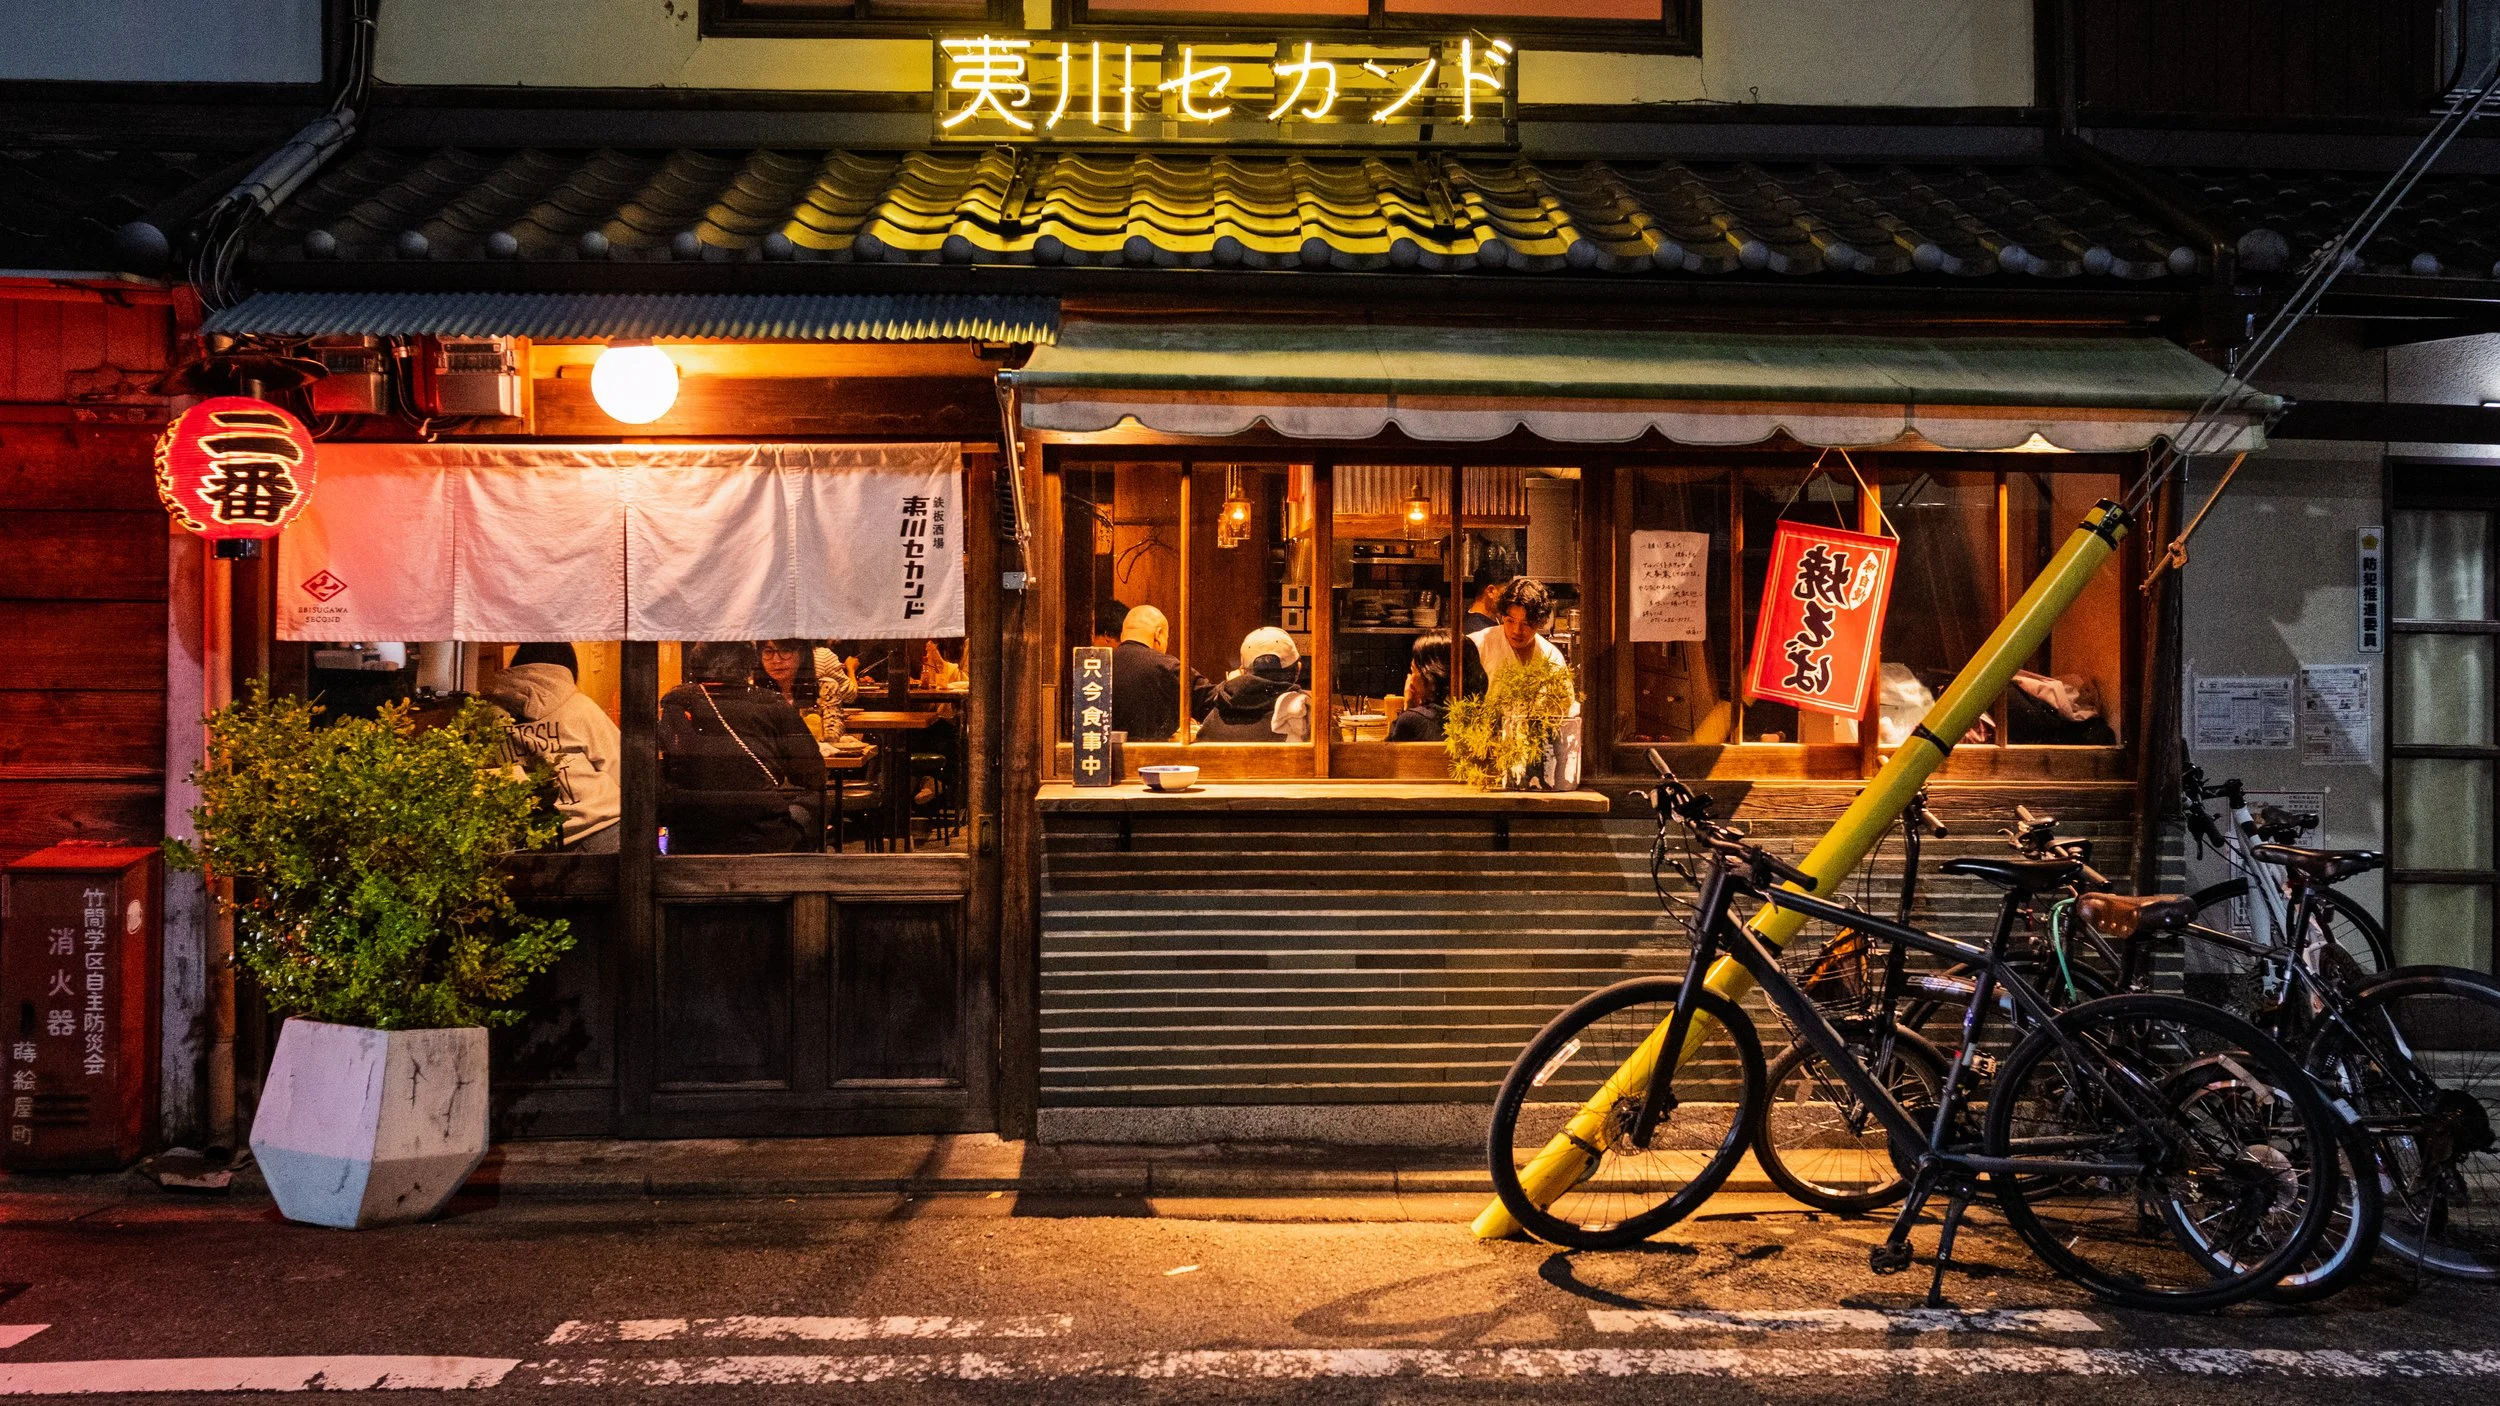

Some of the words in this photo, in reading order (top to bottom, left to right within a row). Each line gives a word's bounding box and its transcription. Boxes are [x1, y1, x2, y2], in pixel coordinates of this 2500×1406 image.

[940, 35, 1513, 132] 夷川セカンド
[198, 410, 303, 526] 二番
[900, 496, 930, 619] 夷川セカンド
[933, 497, 945, 550] 鉄板酒場
[2363, 557, 2378, 647] 防犯推進委員
[1081, 659, 1104, 777] 只今食事中
[47, 927, 77, 1036] 消火器
[83, 888, 106, 1076] 竹間学区自主防災会
[12, 1041, 37, 1145] 蒔絵屋町
